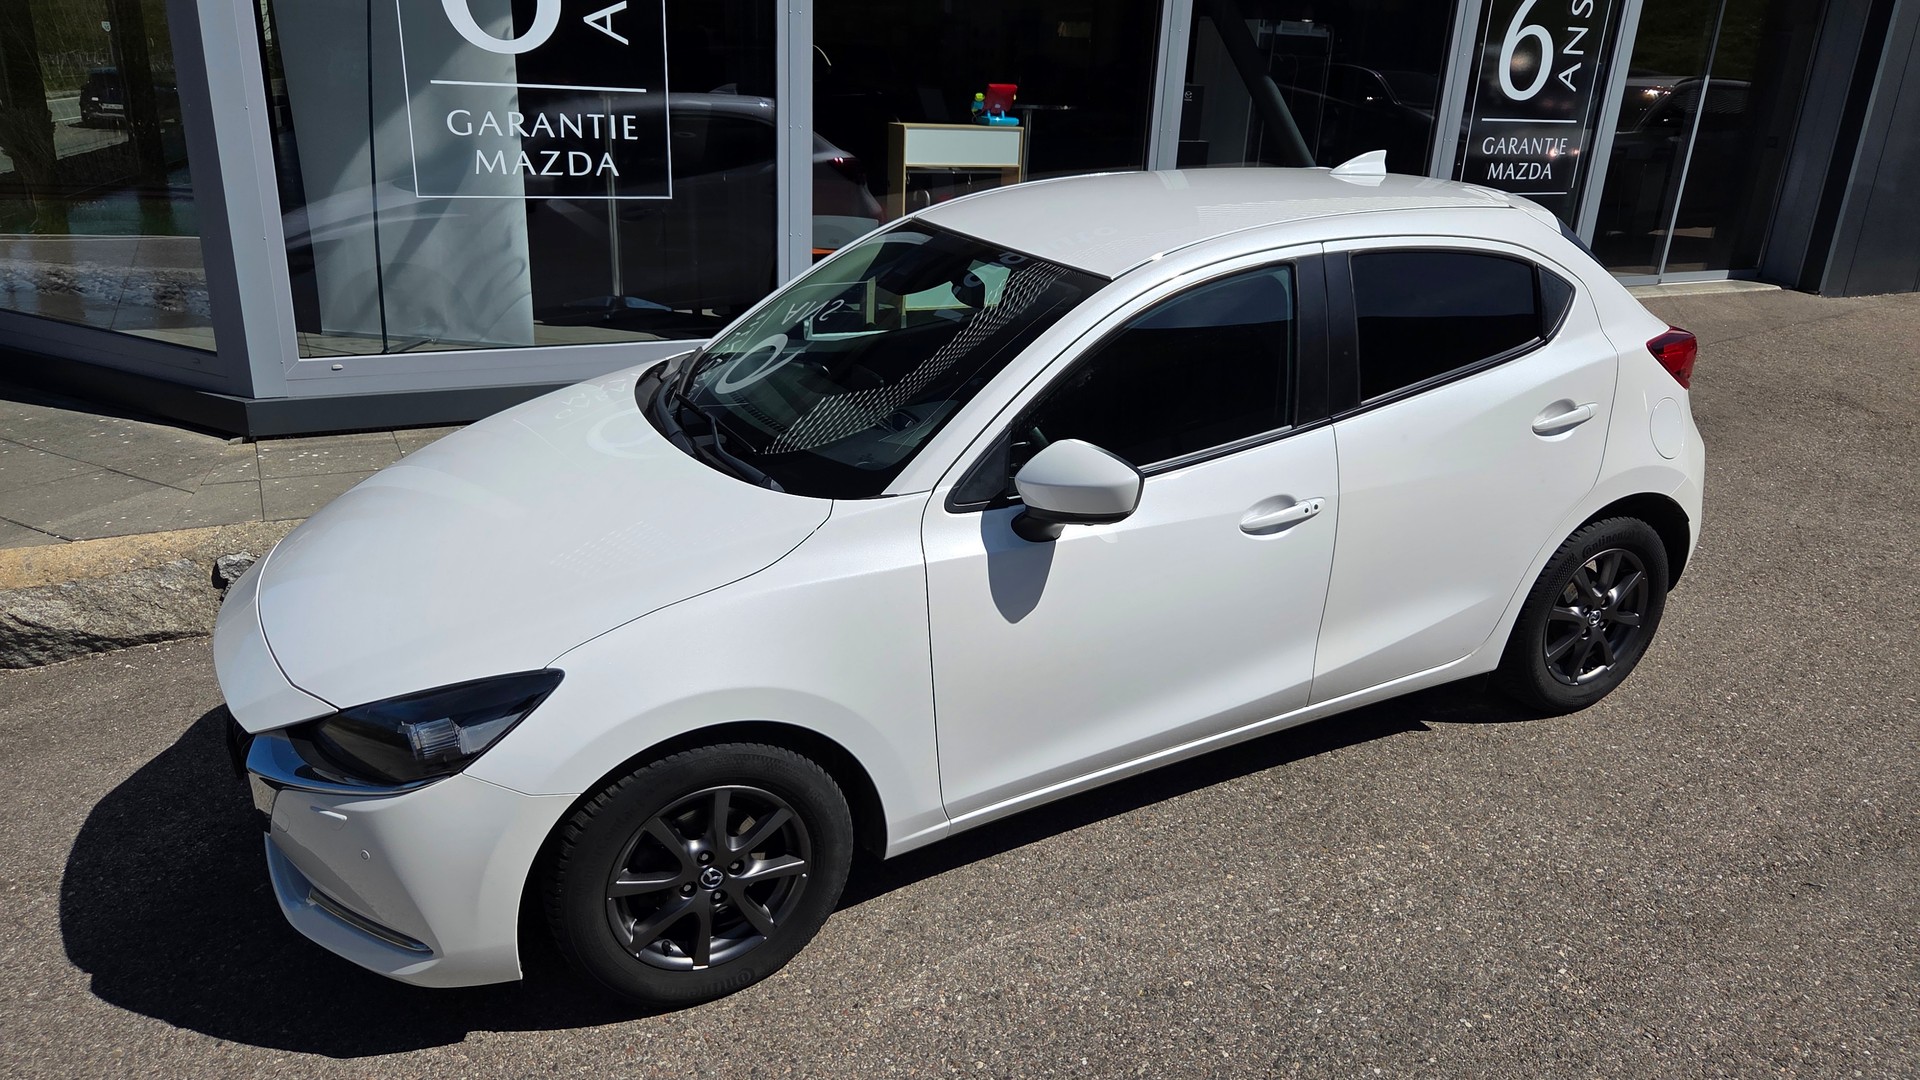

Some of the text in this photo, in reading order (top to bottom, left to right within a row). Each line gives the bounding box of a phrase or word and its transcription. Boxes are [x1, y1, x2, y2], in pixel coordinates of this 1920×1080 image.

[1499, 0, 1554, 101] 6
[1558, 0, 1594, 92] ANS
[446, 109, 639, 141] GARANTIE
[1482, 136, 1569, 155] GARANTIE
[475, 149, 620, 177] MAZDA
[1487, 162, 1552, 180] MAZDA
